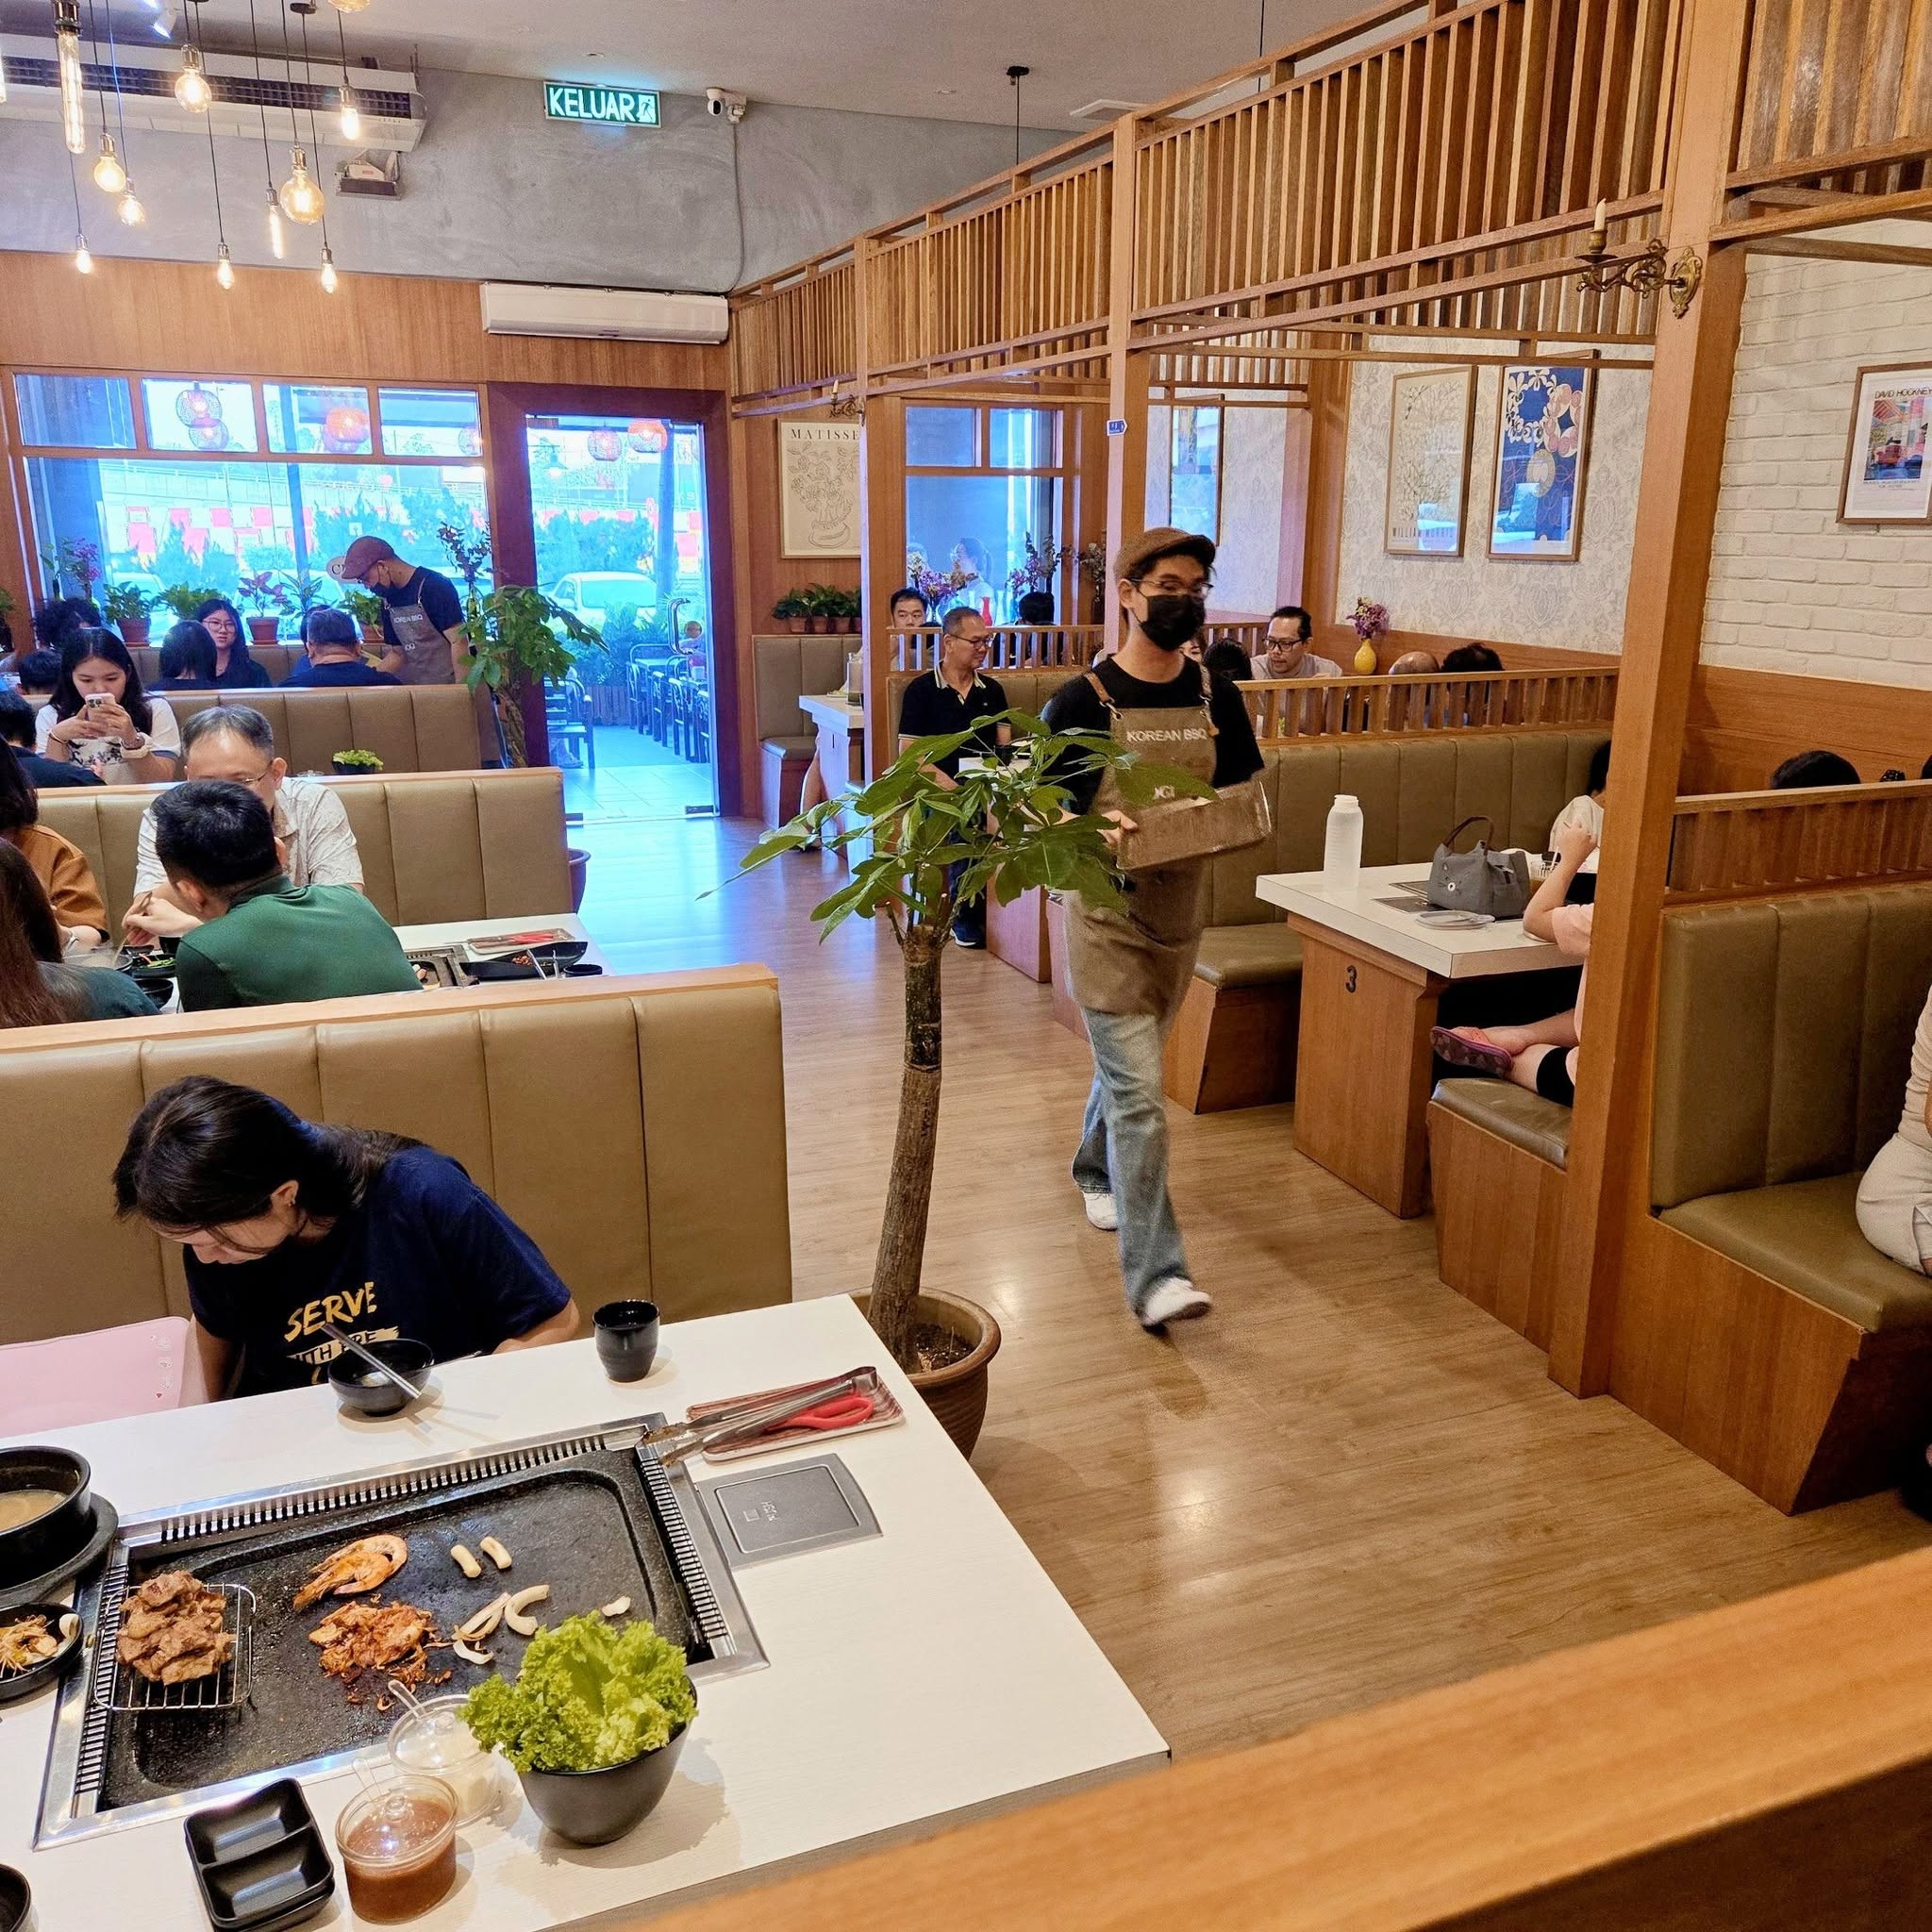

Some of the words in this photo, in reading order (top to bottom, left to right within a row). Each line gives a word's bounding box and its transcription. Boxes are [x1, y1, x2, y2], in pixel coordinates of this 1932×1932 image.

[549, 87, 636, 122] KELUAR
[1874, 390, 1894, 399] DAVID
[1126, 729, 1182, 744] KOREAN
[1183, 727, 1208, 741] BBQ
[1345, 964, 1357, 993] 3
[284, 1281, 377, 1342] SERVE
